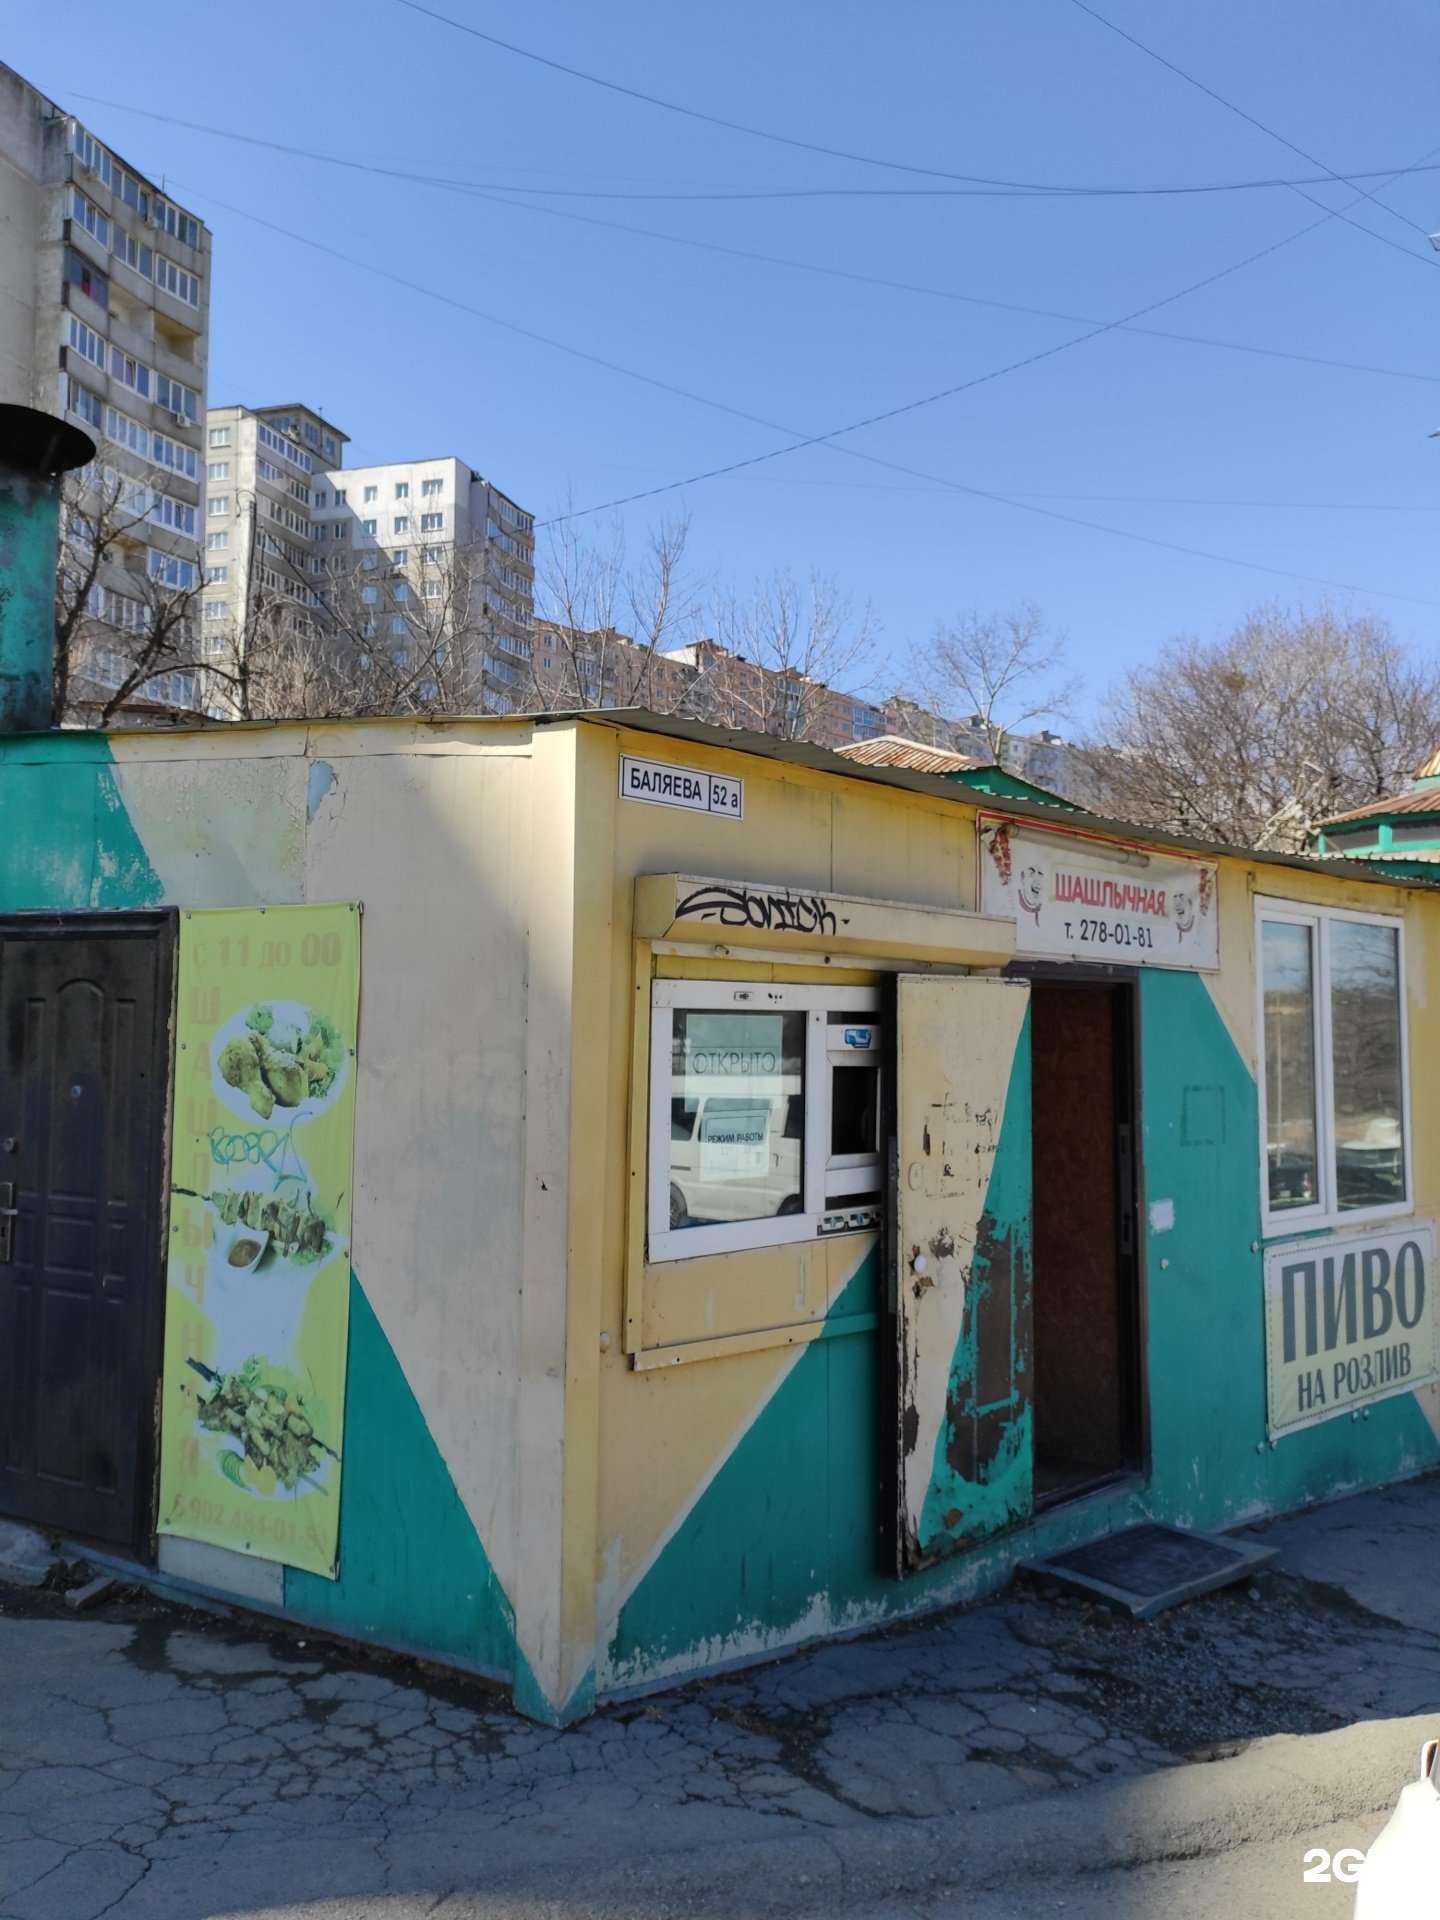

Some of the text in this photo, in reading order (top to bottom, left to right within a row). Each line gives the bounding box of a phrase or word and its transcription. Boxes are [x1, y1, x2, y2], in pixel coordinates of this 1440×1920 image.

[630, 767, 702, 801] БАЛЯЕВА
[712, 784, 728, 806] 52
[1055, 872, 1168, 919] ШАШЛЫЧНАЯ
[218, 934, 250, 968] 11
[301, 932, 341, 967] 00
[1080, 918, 1154, 948] 278-01-81
[692, 1051, 776, 1075] ОТКРЫТО
[707, 1130, 764, 1145] РЕЖИМ РАБОТЫ
[1281, 1240, 1425, 1364] ПИВО
[1297, 1342, 1412, 1412] НА РОЗЛИВ
